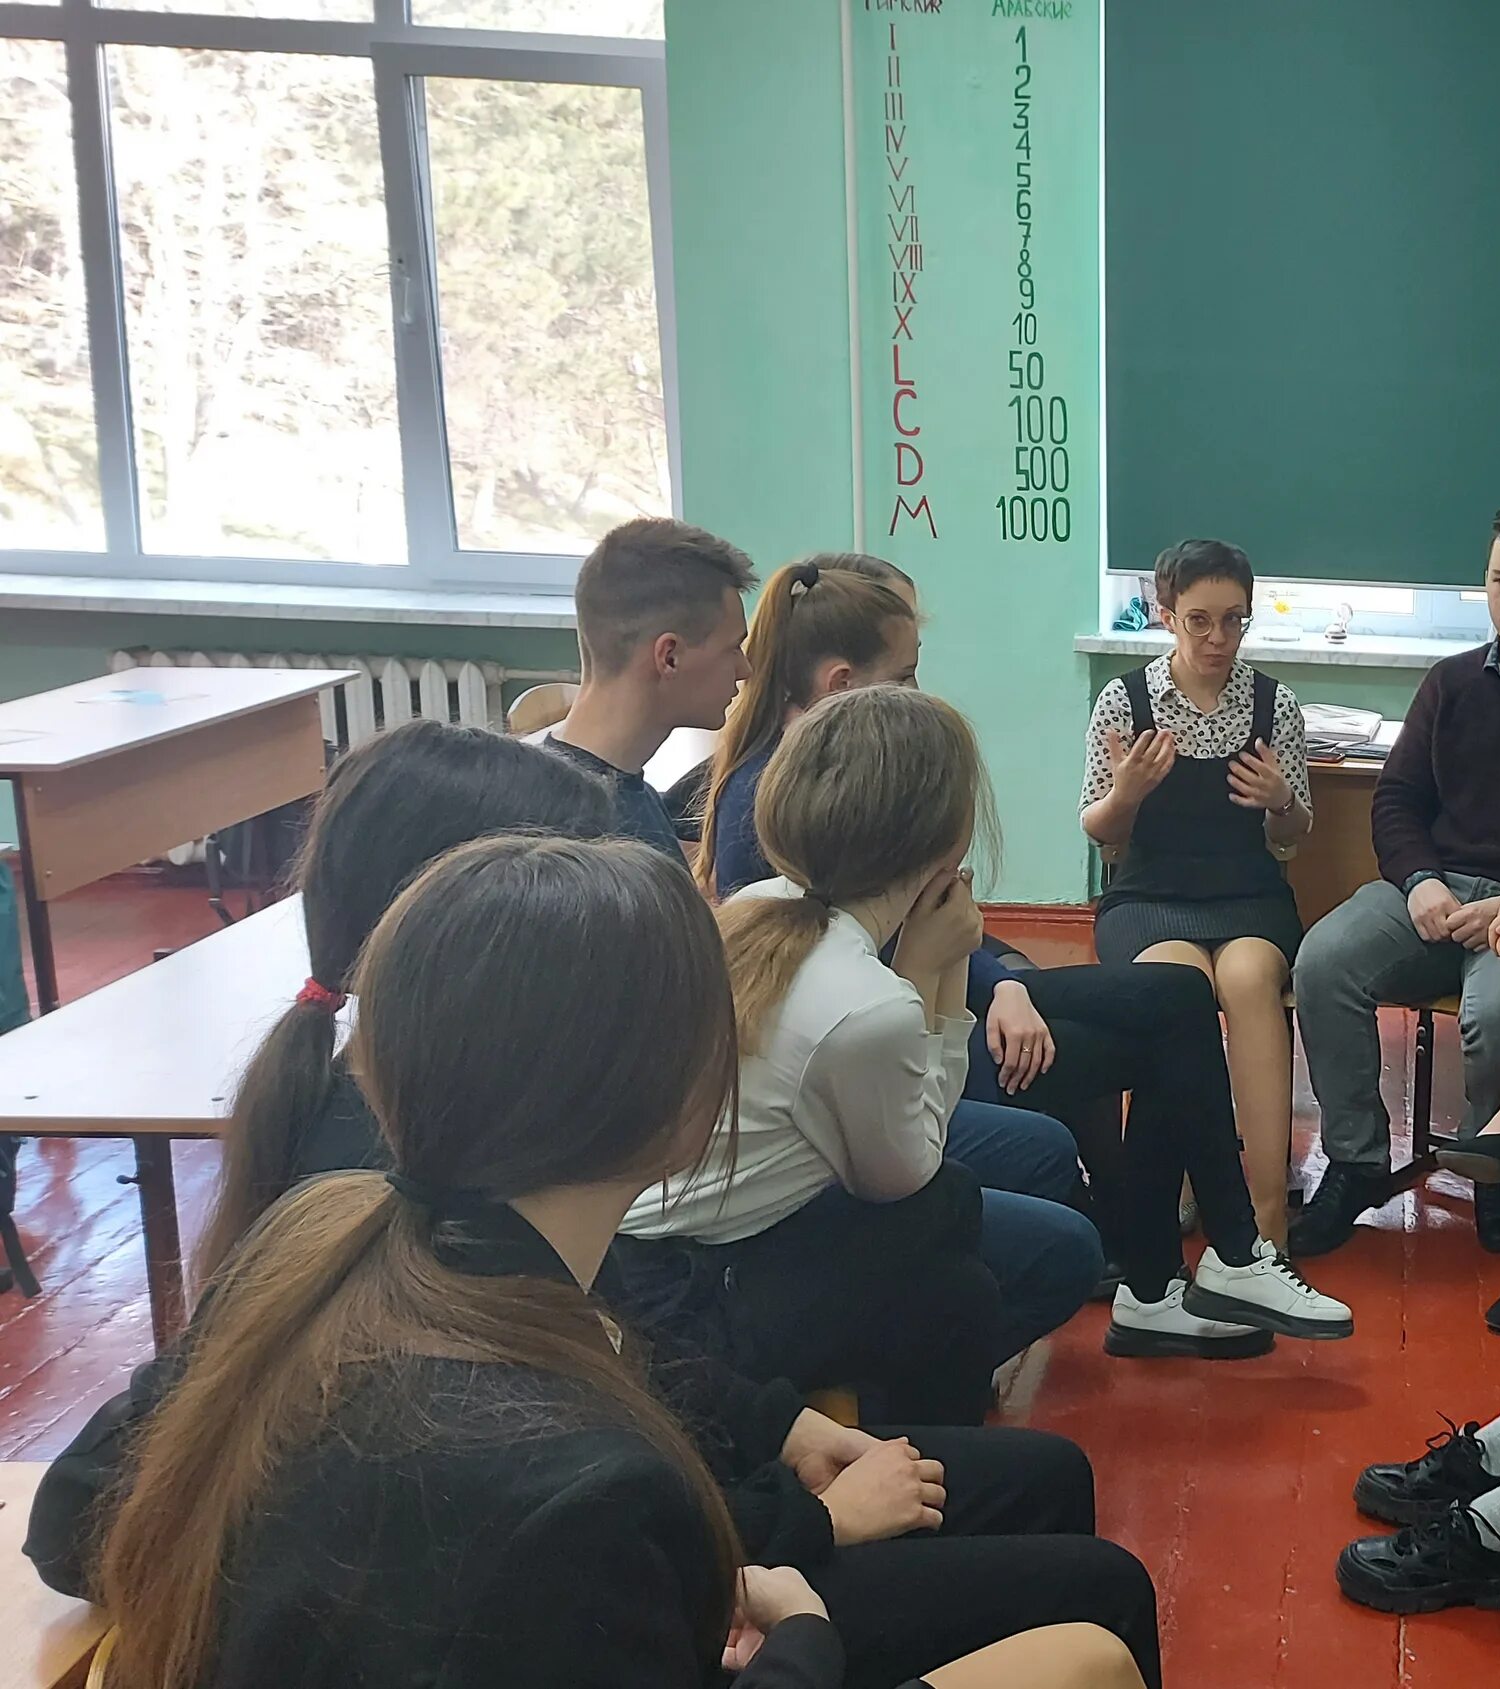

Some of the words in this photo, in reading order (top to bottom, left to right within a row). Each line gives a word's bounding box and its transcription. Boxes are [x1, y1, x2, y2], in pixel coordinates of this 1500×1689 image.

[888, 23, 896, 51] I
[1015, 25, 1028, 63] 1
[888, 56, 900, 87] II
[1014, 65, 1032, 100] 2
[885, 93, 904, 121] III
[1013, 102, 1030, 130] 3
[885, 125, 906, 153] IV
[1015, 130, 1032, 160] 4
[887, 156, 908, 182] V
[1016, 162, 1032, 188] 5
[888, 185, 915, 213] VI
[1016, 189, 1032, 221] 6
[888, 214, 919, 242] VII
[1018, 221, 1032, 249] 7
[888, 243, 924, 272] VIII
[1017, 249, 1032, 280] 8
[892, 272, 918, 305] IX
[1019, 278, 1035, 311] 9
[891, 305, 914, 341] X
[1012, 312, 1038, 346] 10
[893, 344, 915, 386] L
[1008, 350, 1044, 391] 50
[893, 389, 921, 437] C
[1008, 395, 1068, 445] 100
[894, 442, 924, 487] D
[1015, 446, 1070, 493] 500
[887, 494, 938, 541] M
[995, 494, 1072, 543] 1000
